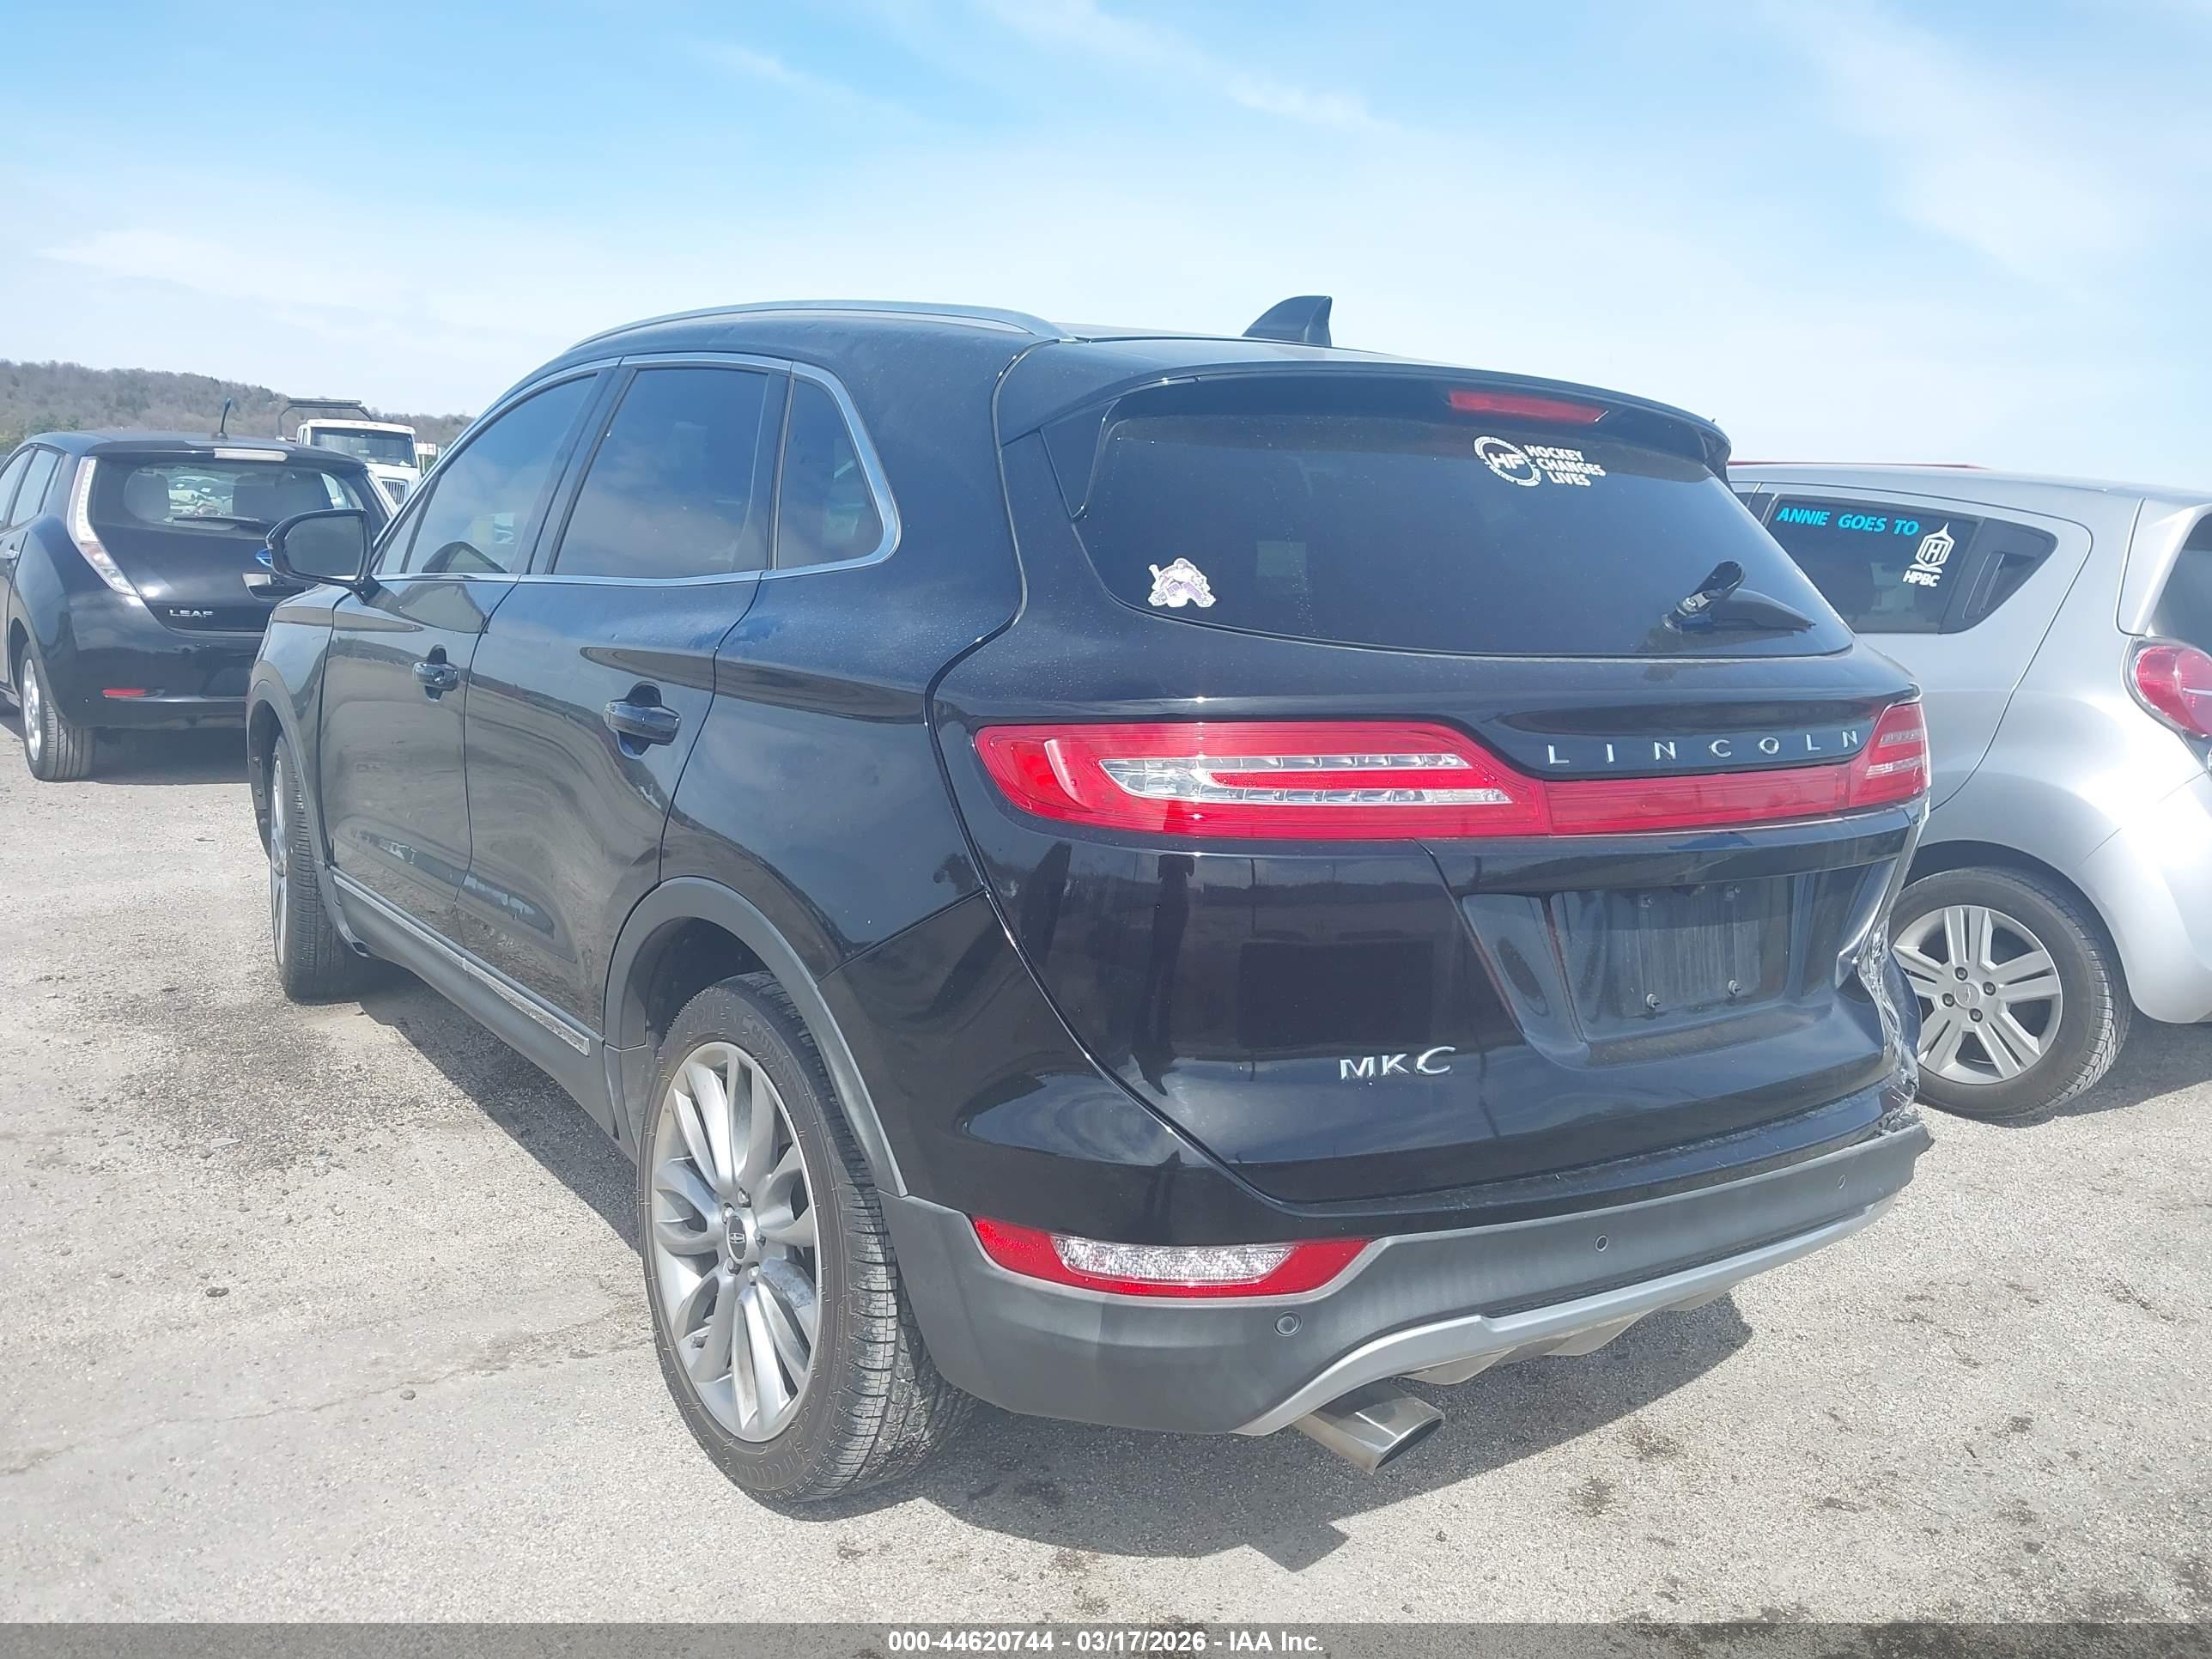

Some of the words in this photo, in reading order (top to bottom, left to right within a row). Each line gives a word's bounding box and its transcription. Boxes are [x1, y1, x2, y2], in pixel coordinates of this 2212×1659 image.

[1523, 445, 1584, 462] HOCKEY
[1536, 458, 1607, 477] CHANGES
[1547, 471, 1591, 487] LIVES
[1776, 507, 1831, 526] ANNIE
[1838, 514, 1887, 532] GOES
[1893, 519, 1920, 536] TO
[1902, 569, 1941, 587] HPBC
[169, 609, 214, 617] LEAF
[1547, 730, 1859, 765] LINCOLN
[1339, 1046, 1456, 1080] MKC
